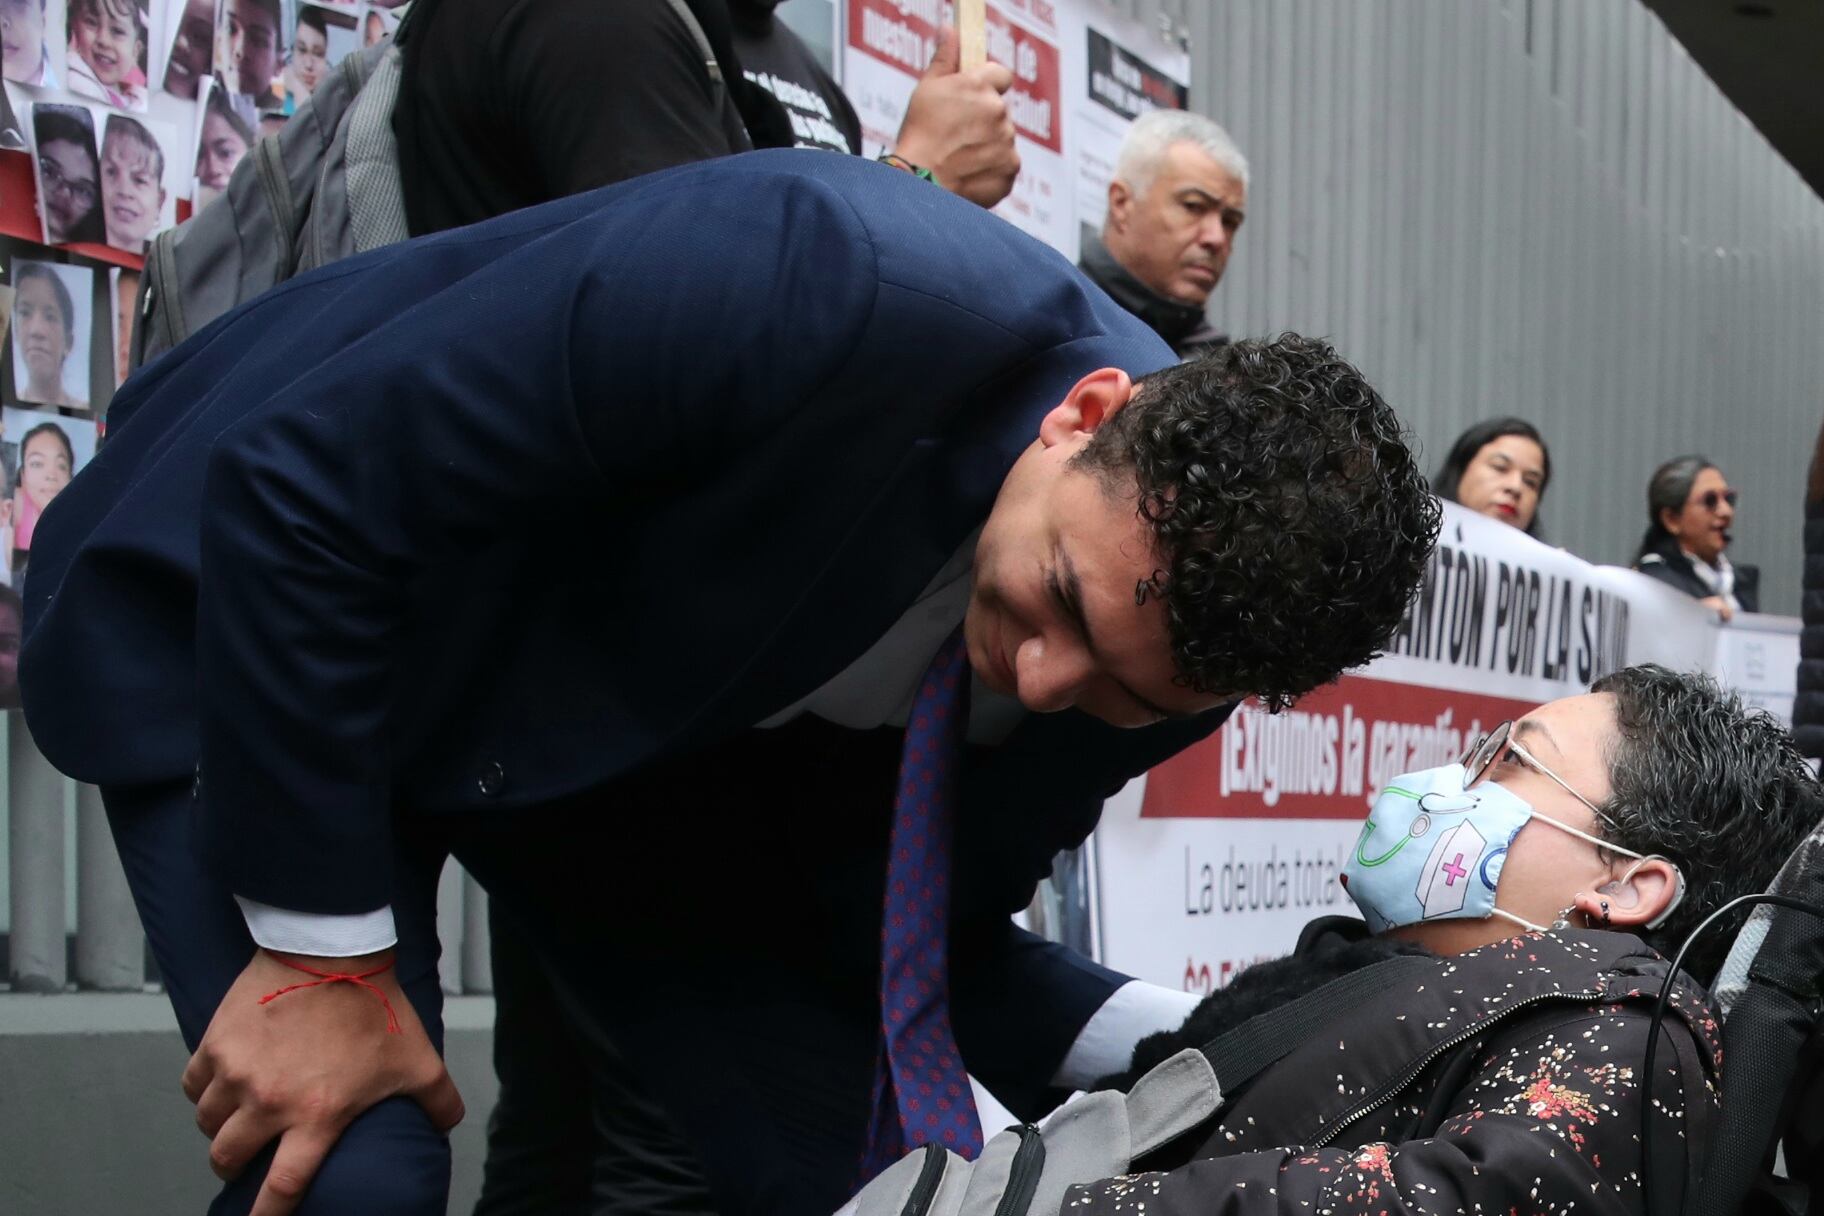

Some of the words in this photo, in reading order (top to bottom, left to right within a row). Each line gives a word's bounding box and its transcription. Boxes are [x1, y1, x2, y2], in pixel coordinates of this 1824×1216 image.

[1490, 561, 1540, 677] POR
[1543, 574, 1572, 681] LA
[1341, 704, 1366, 796] la
[1185, 844, 1214, 915] La
[1220, 844, 1287, 912] deuda
[1294, 844, 1344, 907] total
